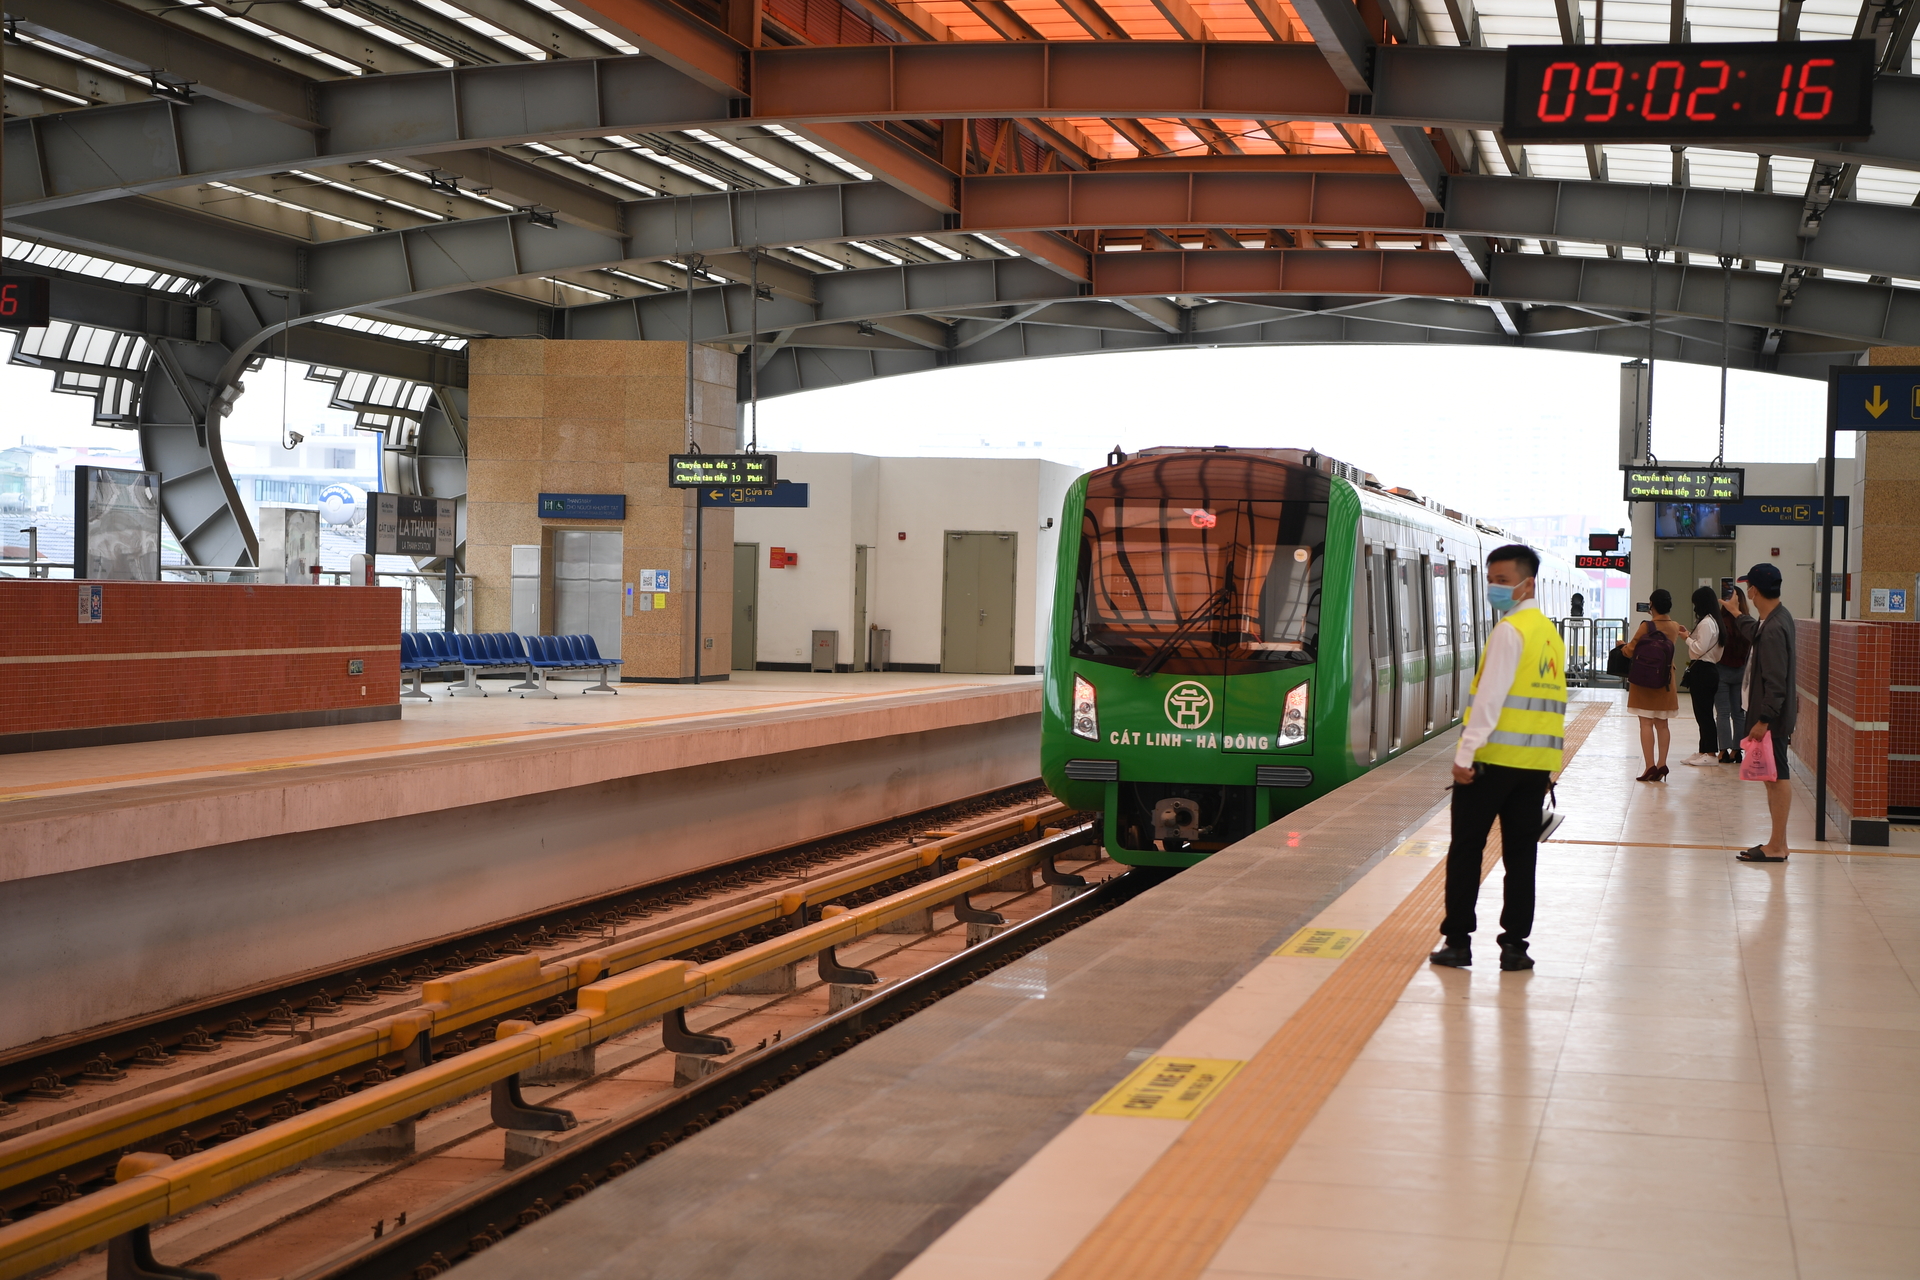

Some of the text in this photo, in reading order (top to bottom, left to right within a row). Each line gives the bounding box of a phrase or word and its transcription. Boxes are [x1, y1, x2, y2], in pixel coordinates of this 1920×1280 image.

[676, 460, 763, 470] Chuyến tàu đến 3 Phút
[676, 473, 701, 483] Chuyến
[714, 473, 727, 482] tiếp
[732, 474, 741, 482] 19
[1632, 473, 1660, 482] Chuyến
[1677, 474, 1691, 482] đến
[1696, 476, 1706, 484] 15
[1631, 486, 1660, 496] Chuyến
[1675, 487, 1690, 497] tiếp
[1694, 489, 1706, 497] 30
[414, 500, 422, 513] GA
[1760, 504, 1780, 513] Cửa
[399, 519, 410, 536] LA
[1110, 729, 1141, 745] CÁT
[1146, 732, 1182, 747] LINH
[1196, 733, 1217, 748] HÀ
[1224, 733, 1268, 750] ĐÔNG
